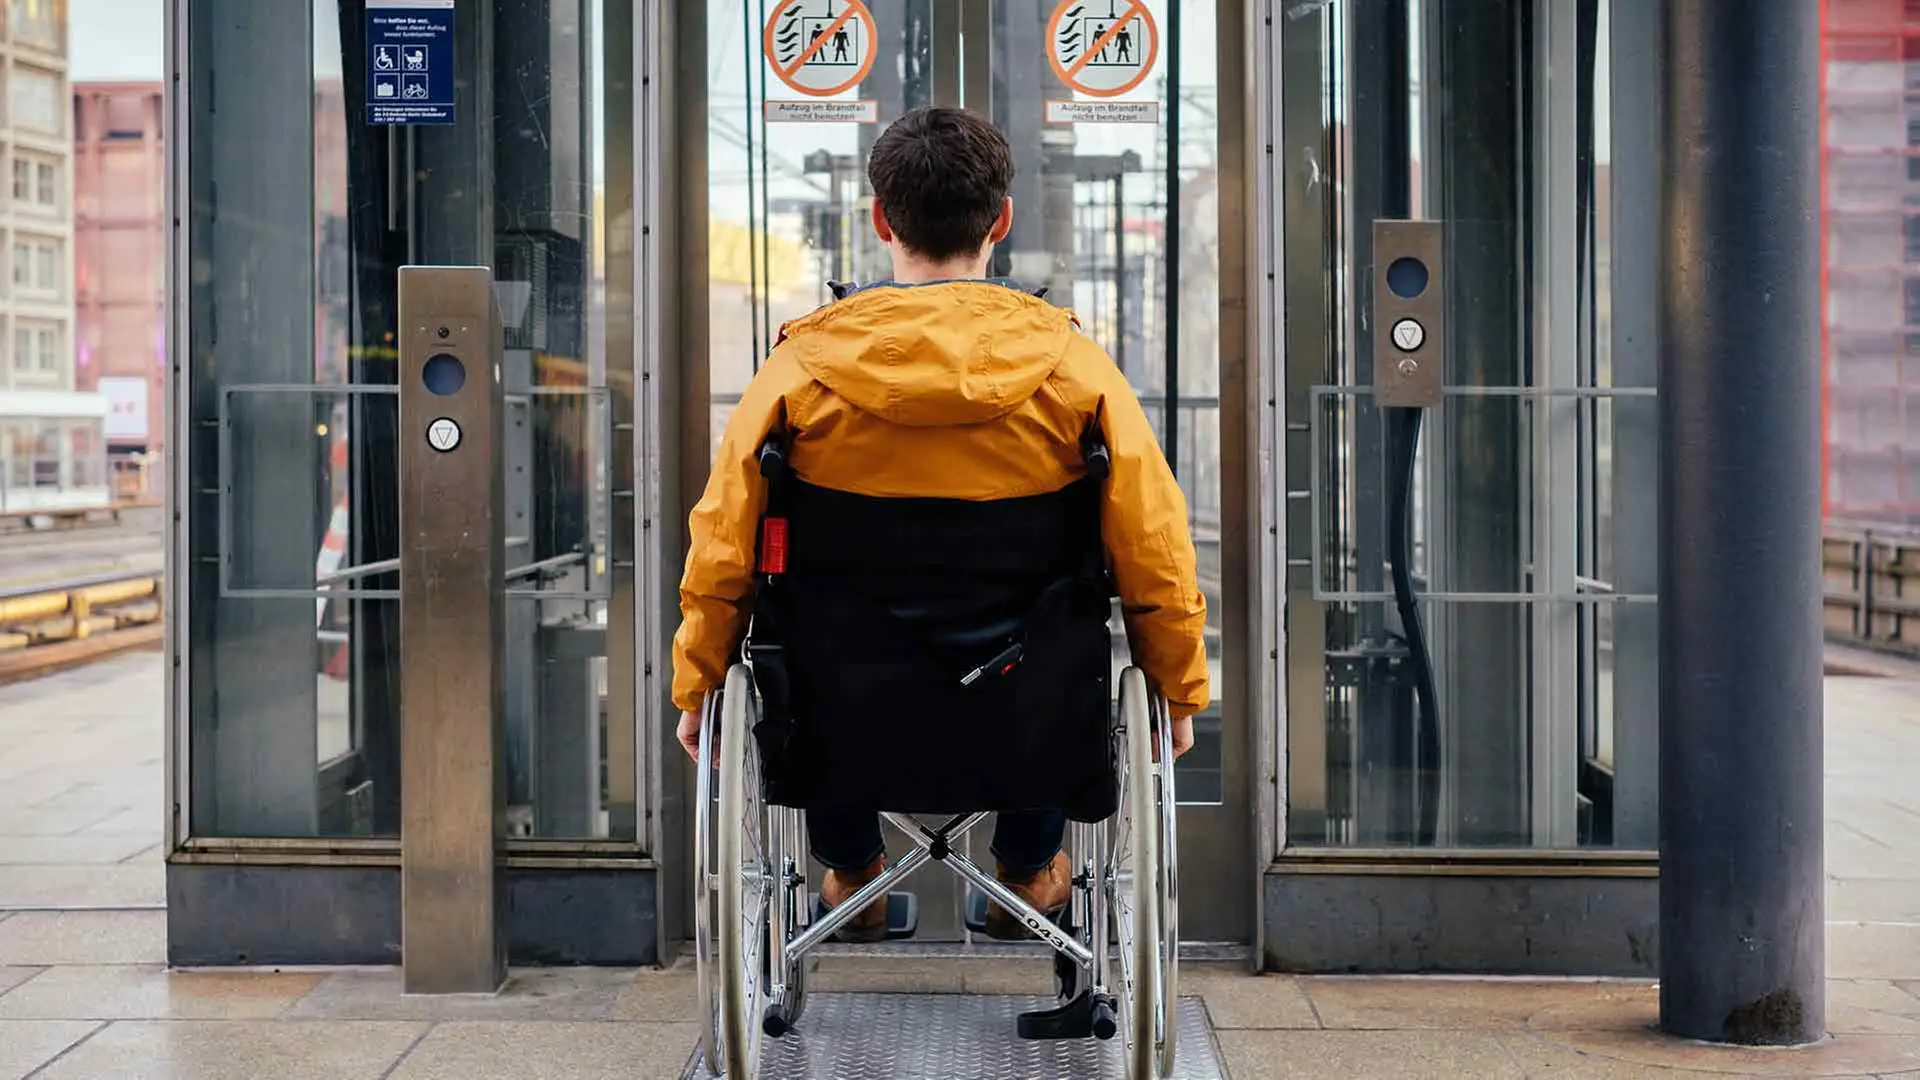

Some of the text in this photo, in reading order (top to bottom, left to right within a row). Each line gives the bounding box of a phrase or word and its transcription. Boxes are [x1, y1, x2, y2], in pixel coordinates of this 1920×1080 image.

[779, 103, 866, 113] Aufzug im Brandfall
[1062, 103, 1093, 113] Aufzug
[1108, 103, 1149, 112] Brandfall
[790, 112, 855, 120] nicht benutzen
[1072, 112, 1137, 120] nicht benutzen
[1027, 917, 1064, 948] 043
